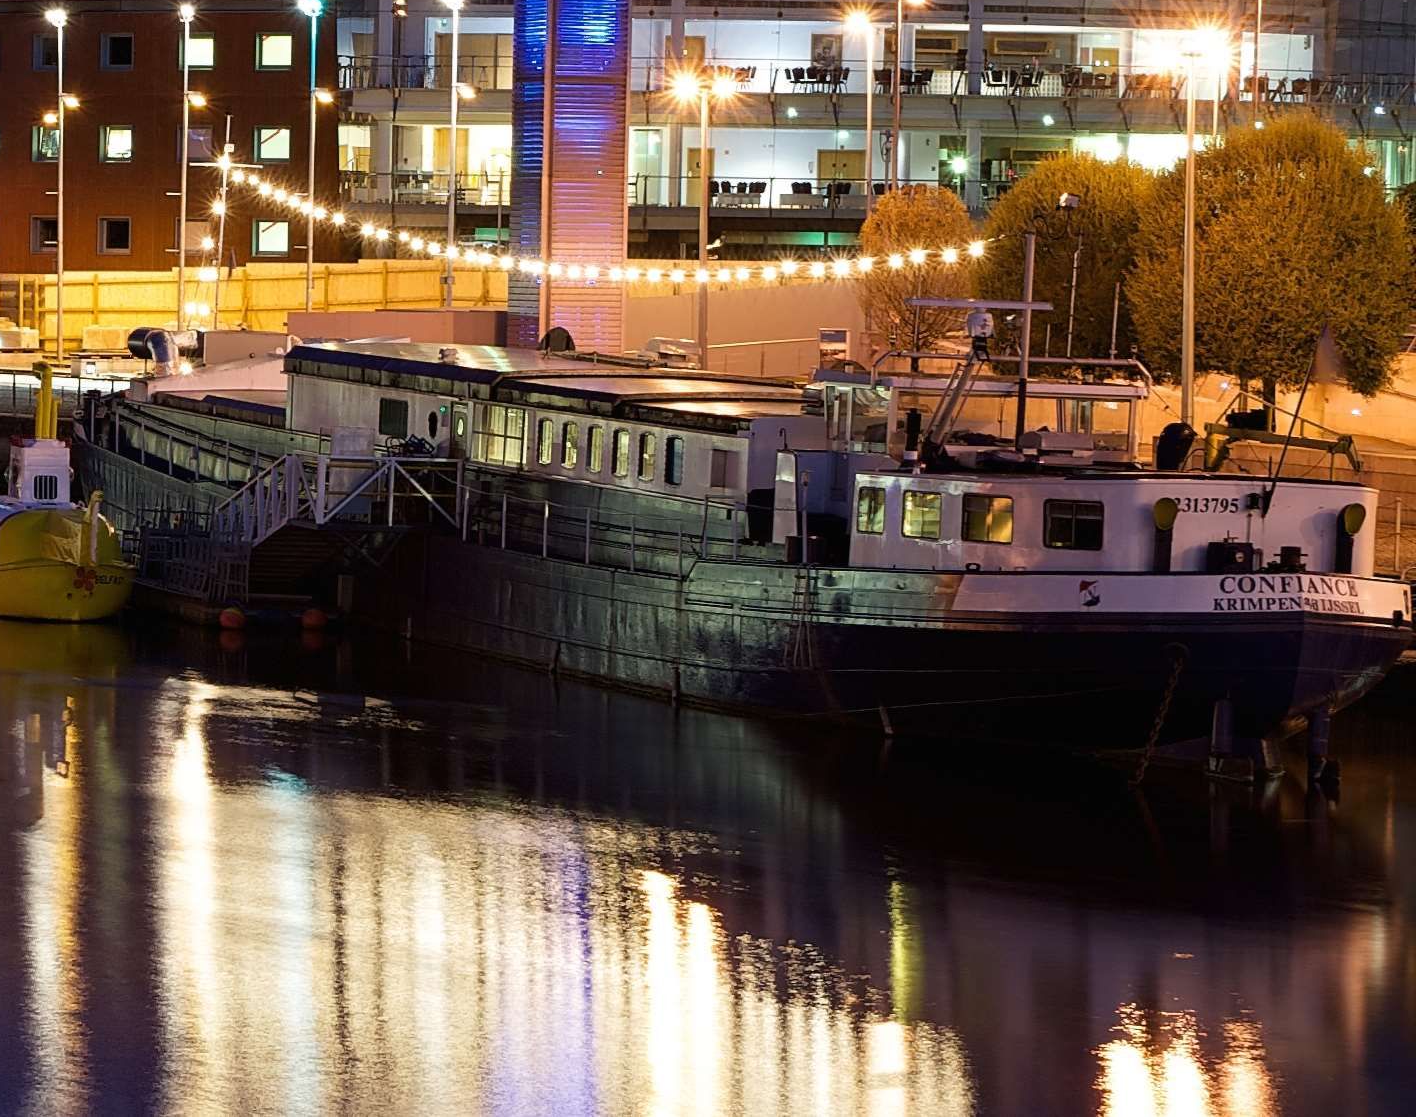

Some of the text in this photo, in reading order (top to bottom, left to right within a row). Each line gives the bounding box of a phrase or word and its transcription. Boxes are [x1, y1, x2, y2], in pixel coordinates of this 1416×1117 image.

[1219, 576, 1358, 597] CONFIANCE
[1213, 596, 1303, 611] KRIMPEN
[1320, 599, 1365, 615] IJSSEL
